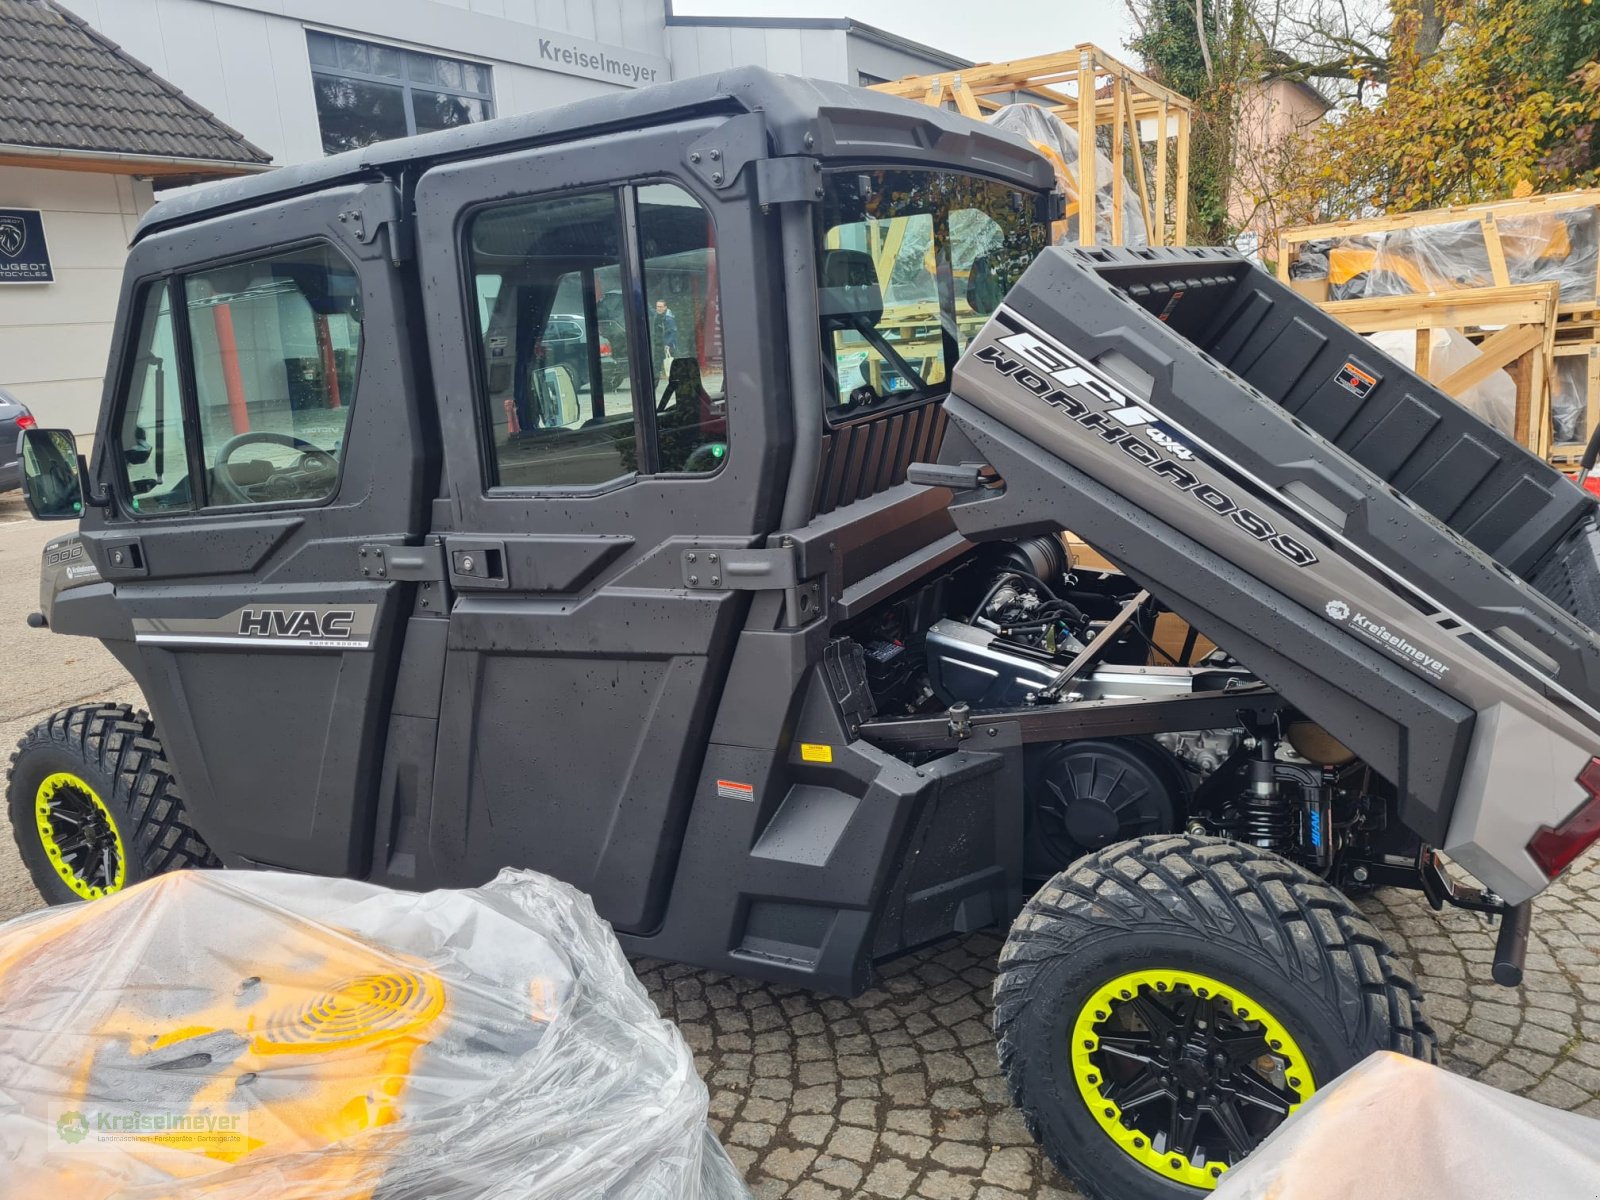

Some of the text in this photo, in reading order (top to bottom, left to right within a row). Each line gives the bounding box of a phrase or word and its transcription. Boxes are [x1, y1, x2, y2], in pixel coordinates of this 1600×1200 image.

[538, 38, 657, 82] Kreiselmeyer
[995, 332, 1158, 427] EFI
[972, 345, 1320, 567] WORKCROSS
[46, 545, 84, 567] 1000
[238, 609, 355, 638] HVAC
[1351, 612, 1450, 674] Kreiselmeyer
